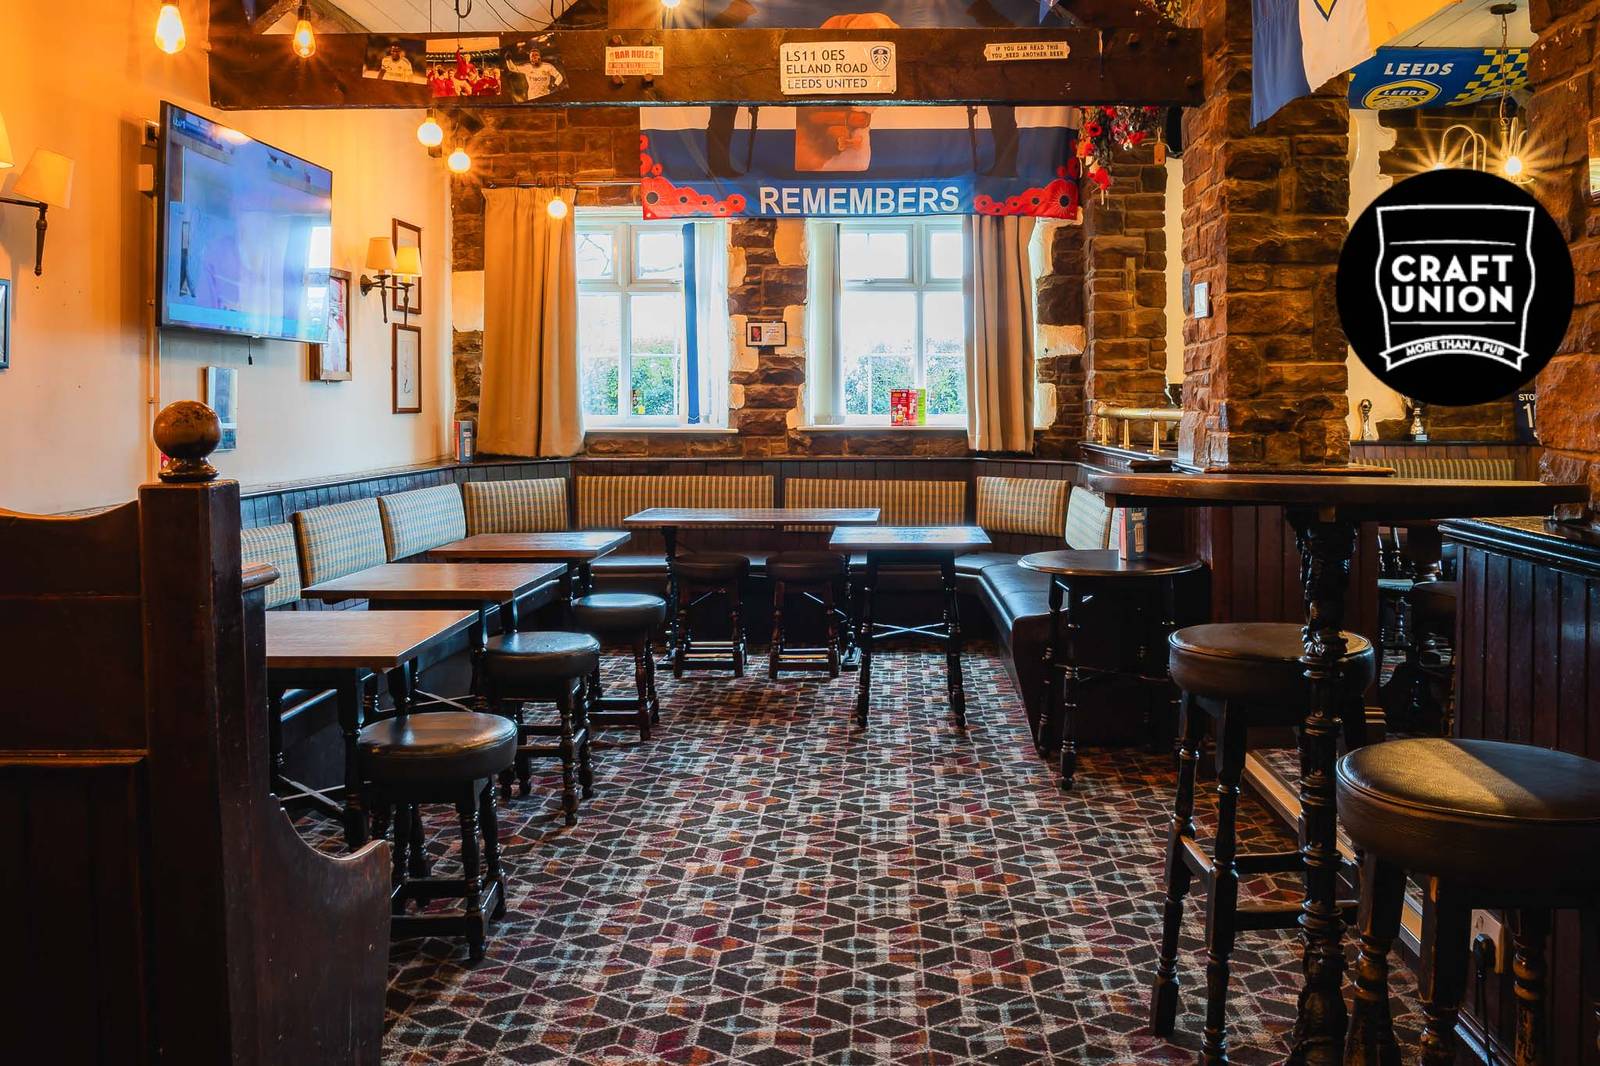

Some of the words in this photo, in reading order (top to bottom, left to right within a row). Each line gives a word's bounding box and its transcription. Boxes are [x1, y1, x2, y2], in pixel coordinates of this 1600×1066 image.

[614, 50, 630, 60] BAR
[786, 50, 814, 62] LS11
[786, 64, 832, 74] ELLAND
[835, 63, 868, 74] ROAD
[1383, 62, 1455, 76] LEEDS
[787, 79, 822, 88] LEEDS
[826, 78, 868, 88] UNITED
[759, 186, 960, 215] REMEMBERS
[1522, 403, 1537, 428] 1
